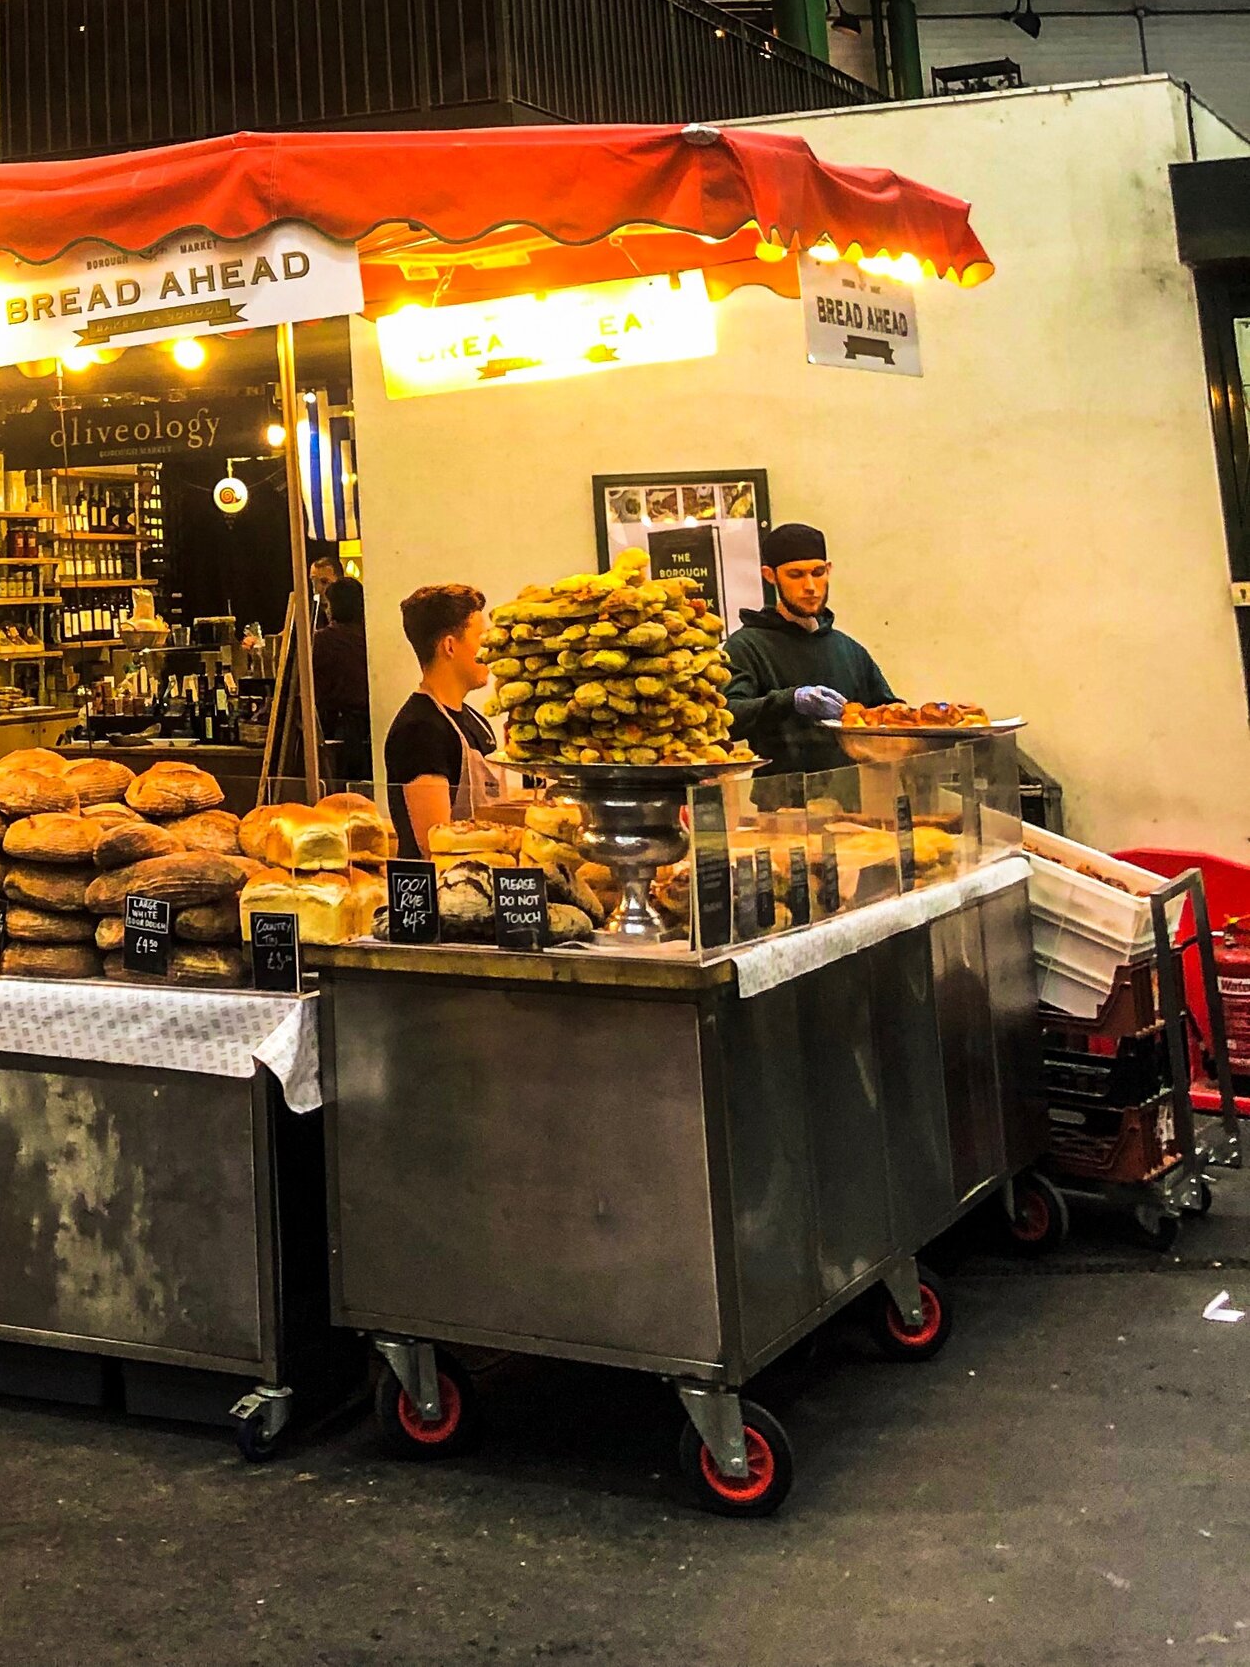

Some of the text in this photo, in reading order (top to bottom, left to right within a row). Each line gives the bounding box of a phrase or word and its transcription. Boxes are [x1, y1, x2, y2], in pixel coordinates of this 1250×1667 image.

[86, 239, 217, 270] BOROUGH MARKET
[5, 251, 310, 325] BREAD AHEAD
[166, 305, 223, 322] SCHOOL
[816, 296, 909, 337] BREAD AHEAD
[50, 407, 220, 448] oliveology
[671, 552, 691, 563] THE
[659, 567, 708, 578] BOROUGH
[397, 878, 427, 893] 100%
[499, 877, 536, 891] PLEASE
[133, 898, 158, 910] LARGE
[400, 893, 424, 909] RYE
[499, 894, 540, 906] DO NOT
[131, 909, 158, 920] WHITE
[503, 910, 541, 924] TOUCH
